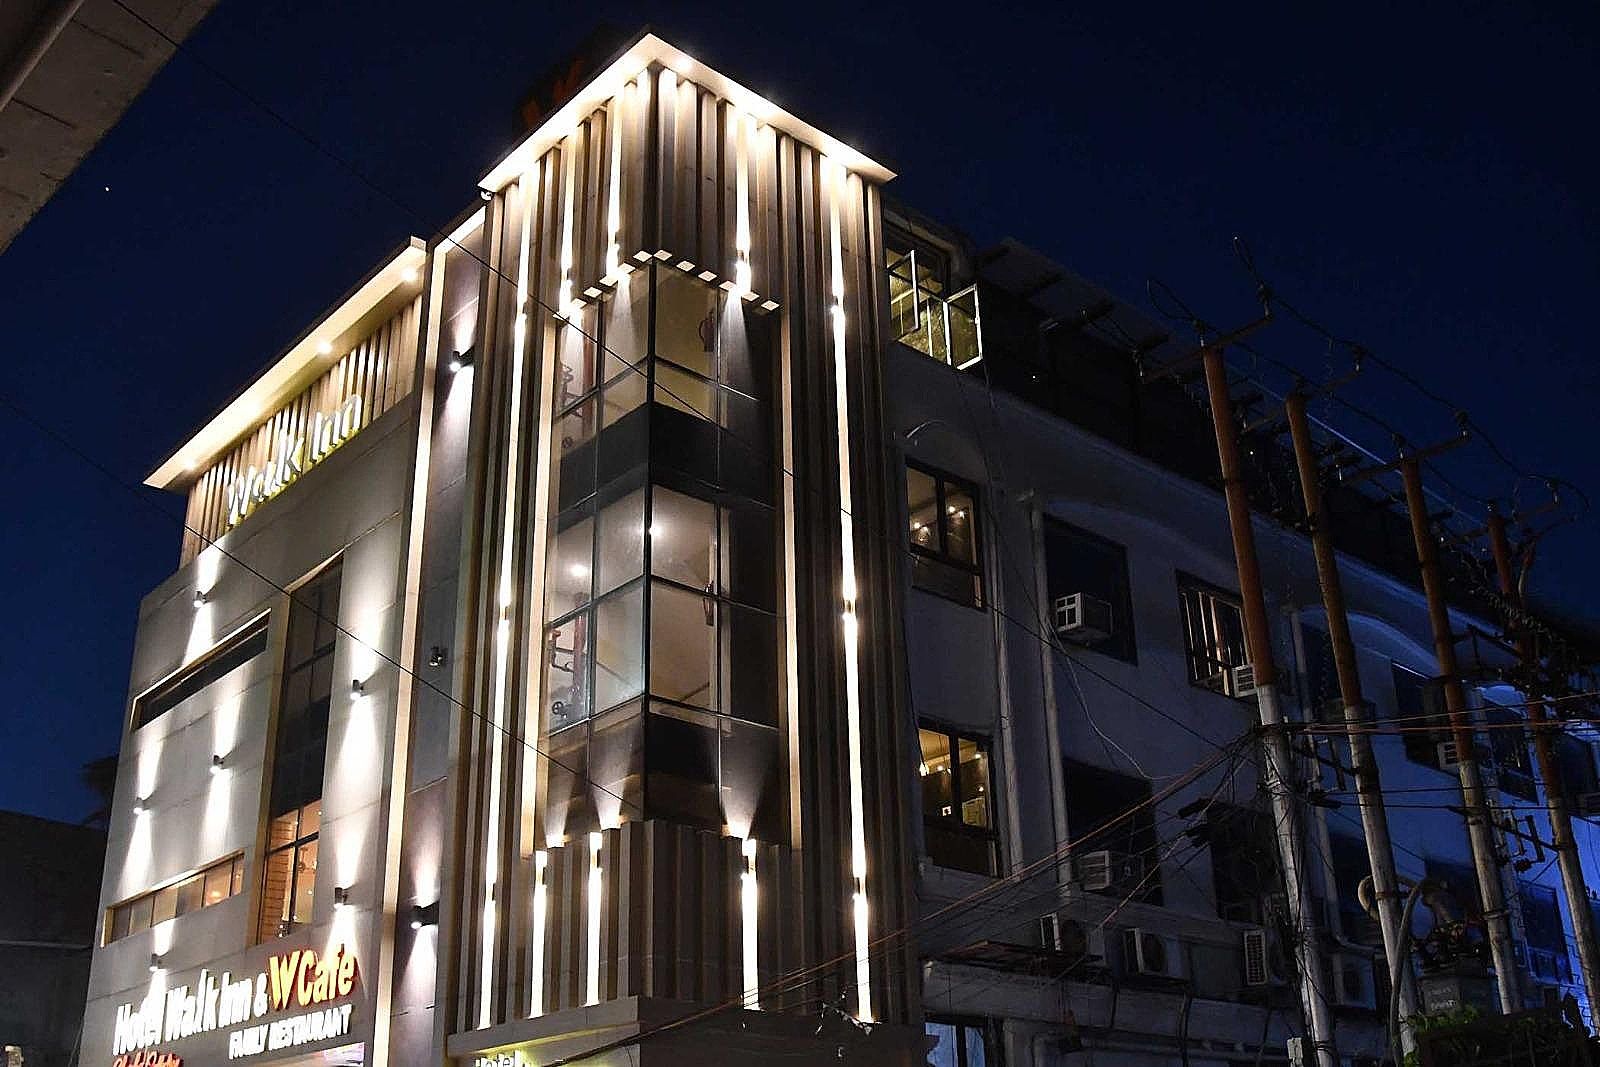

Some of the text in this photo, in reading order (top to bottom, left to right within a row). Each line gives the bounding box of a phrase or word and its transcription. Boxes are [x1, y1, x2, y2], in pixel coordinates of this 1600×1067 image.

[227, 394, 362, 525] Walk Inn
[112, 992, 165, 1056] Hotel
[164, 968, 220, 1042] Walk
[218, 971, 253, 1028] Inn
[253, 972, 269, 1018] &
[268, 1003, 353, 1051] RESTAURANT
